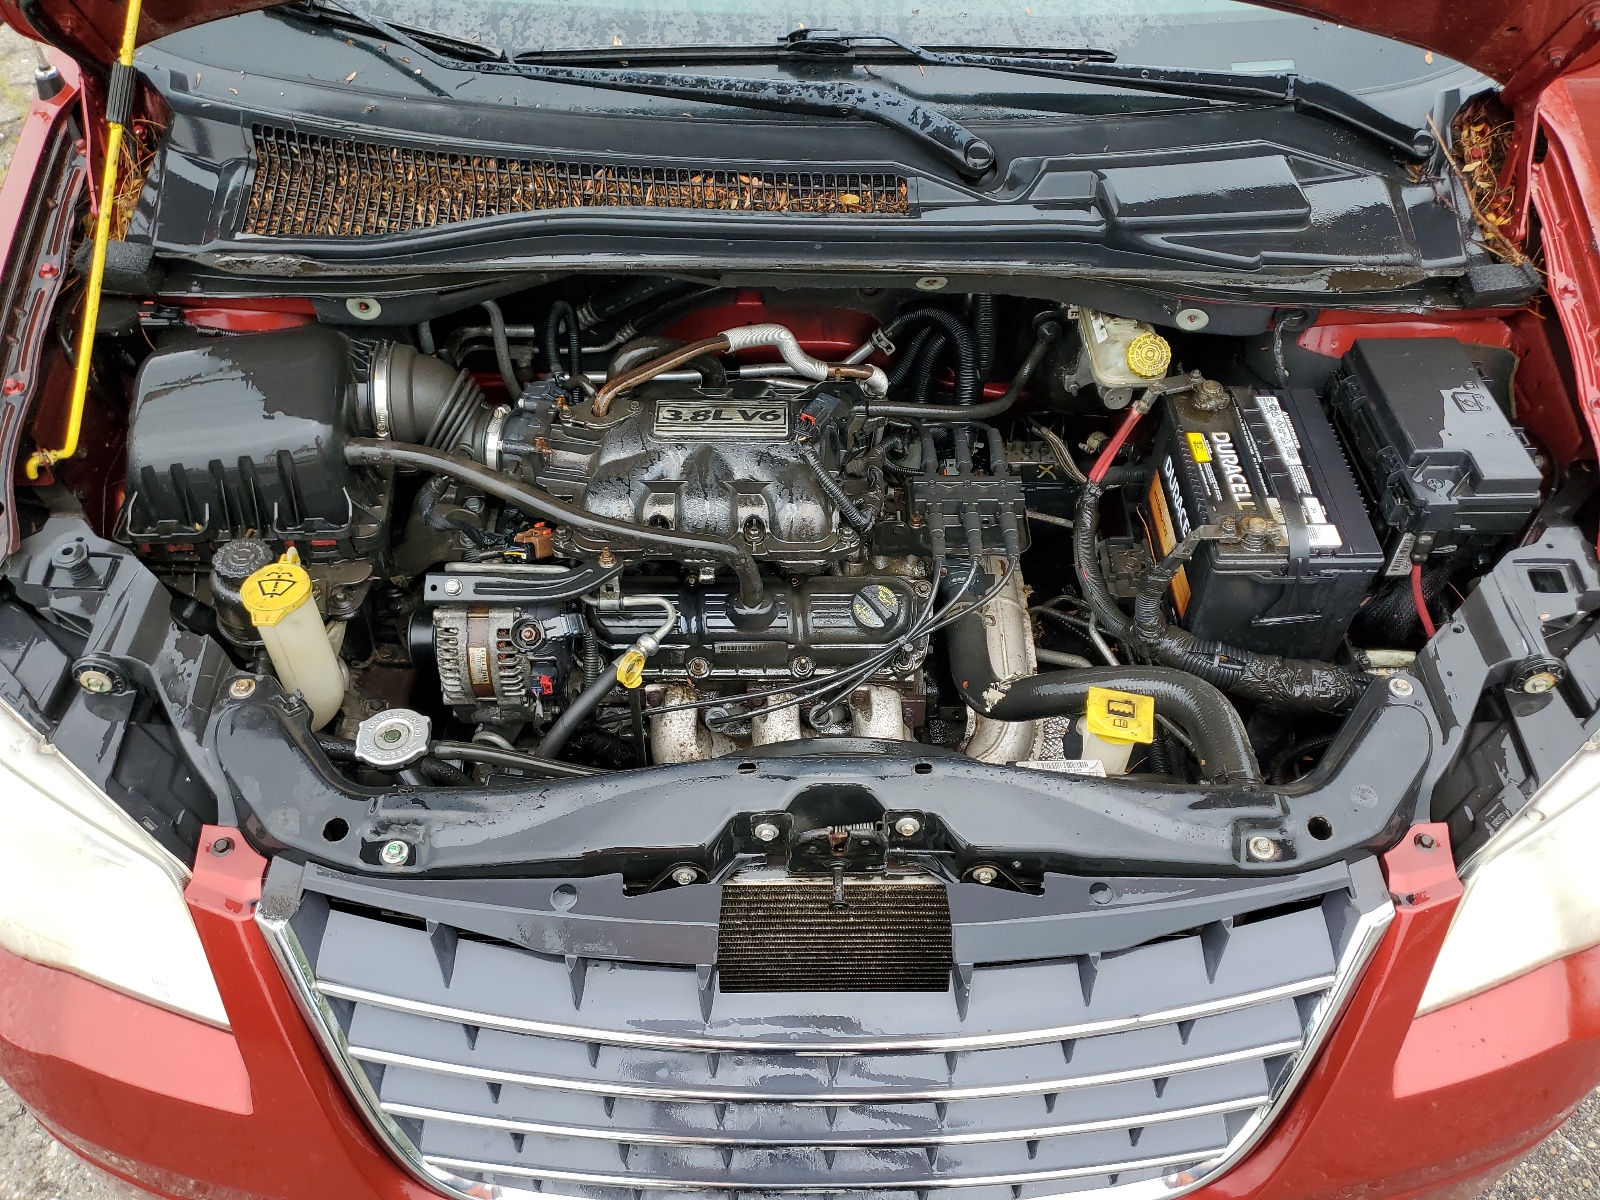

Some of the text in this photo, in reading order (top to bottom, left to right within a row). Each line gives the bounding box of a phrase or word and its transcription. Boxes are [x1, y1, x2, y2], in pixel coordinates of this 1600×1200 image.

[662, 409, 782, 422] 3.8L V6
[1163, 455, 1192, 538] DURACE
[1211, 431, 1256, 511] DURACELL
